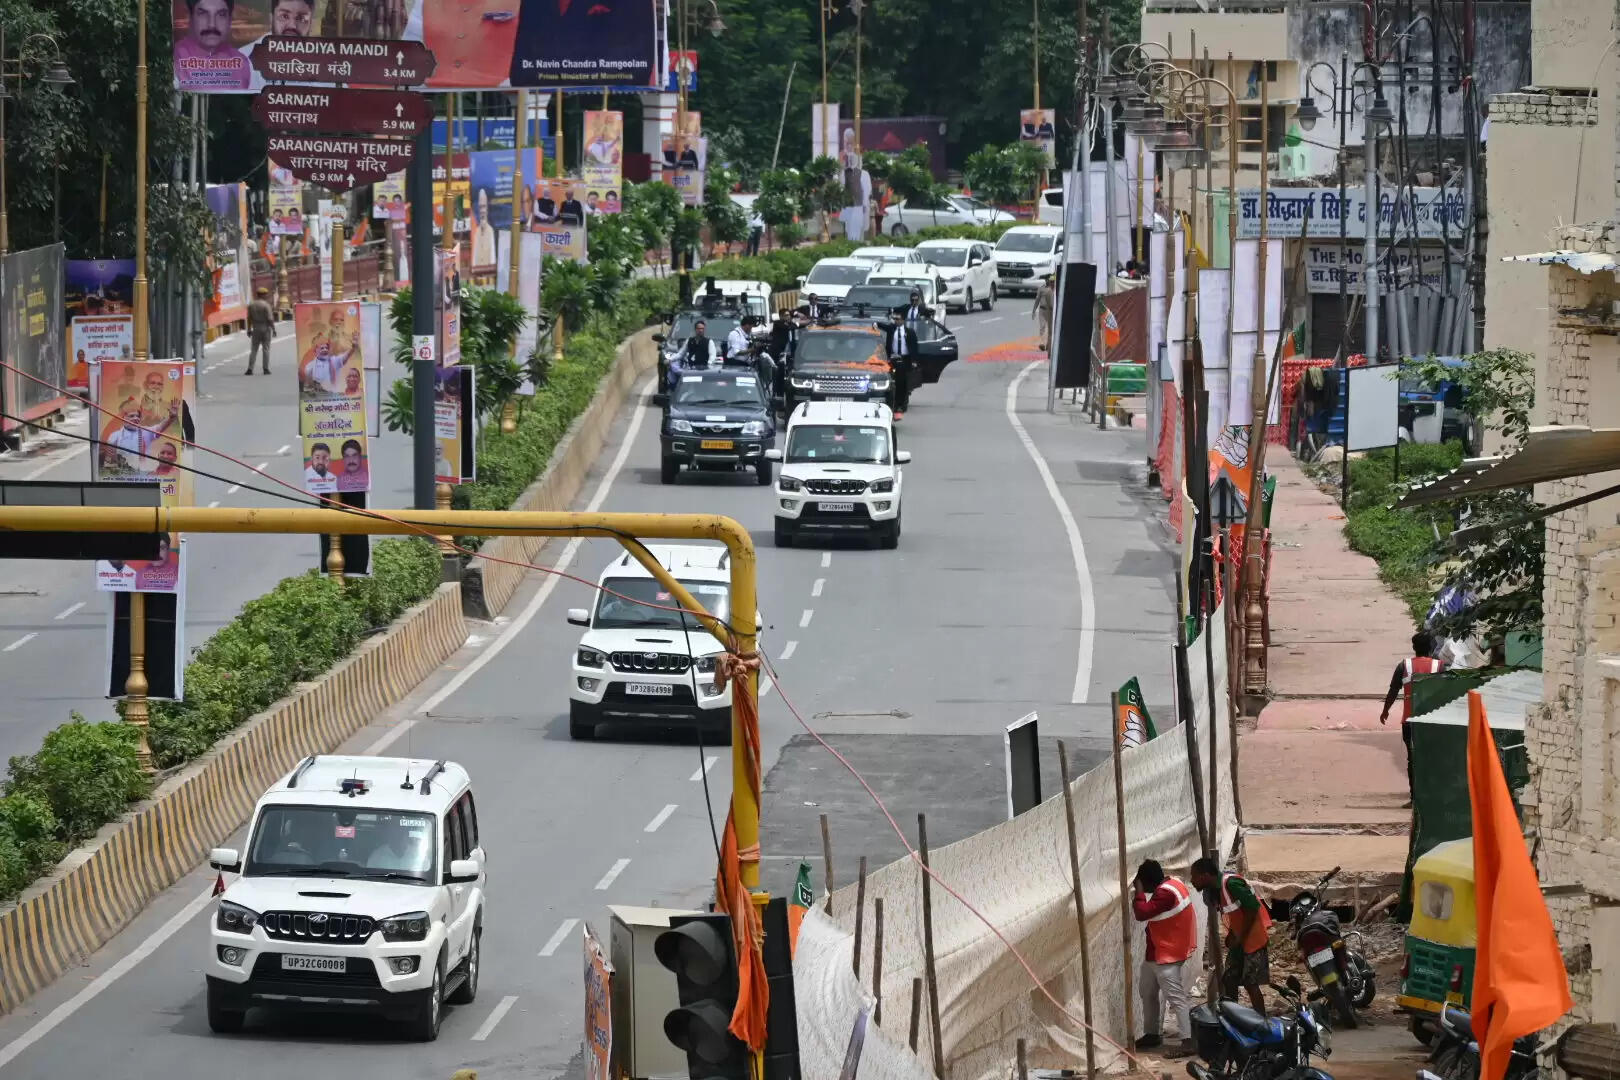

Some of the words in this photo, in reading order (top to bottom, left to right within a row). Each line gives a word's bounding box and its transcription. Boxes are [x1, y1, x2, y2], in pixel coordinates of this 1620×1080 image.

[268, 40, 336, 55] PAHADIYA
[340, 43, 388, 57] MANDI
[268, 59, 320, 76] पहाड़िया
[328, 60, 352, 77] मंडी
[522, 59, 535, 69] Dr.
[536, 59, 560, 69] Navin
[562, 59, 597, 69] Chandra
[599, 58, 648, 70] Ramgoolam
[384, 68, 398, 78] 3.4
[400, 70, 416, 79] KM
[267, 92, 330, 107] SARNATH
[268, 111, 319, 125] सारनाथ
[382, 120, 397, 129] 5.9
[399, 121, 415, 130] KM
[269, 138, 358, 154] SARANGNATH
[361, 143, 412, 157] TEMPLE
[290, 155, 350, 171] सारंगनाथ
[355, 157, 388, 172] मंदिर
[311, 172, 326, 181] 6.9
[327, 173, 343, 182] KM
[1309, 247, 1337, 263] THE
[288, 957, 345, 970] UP32CG0008
